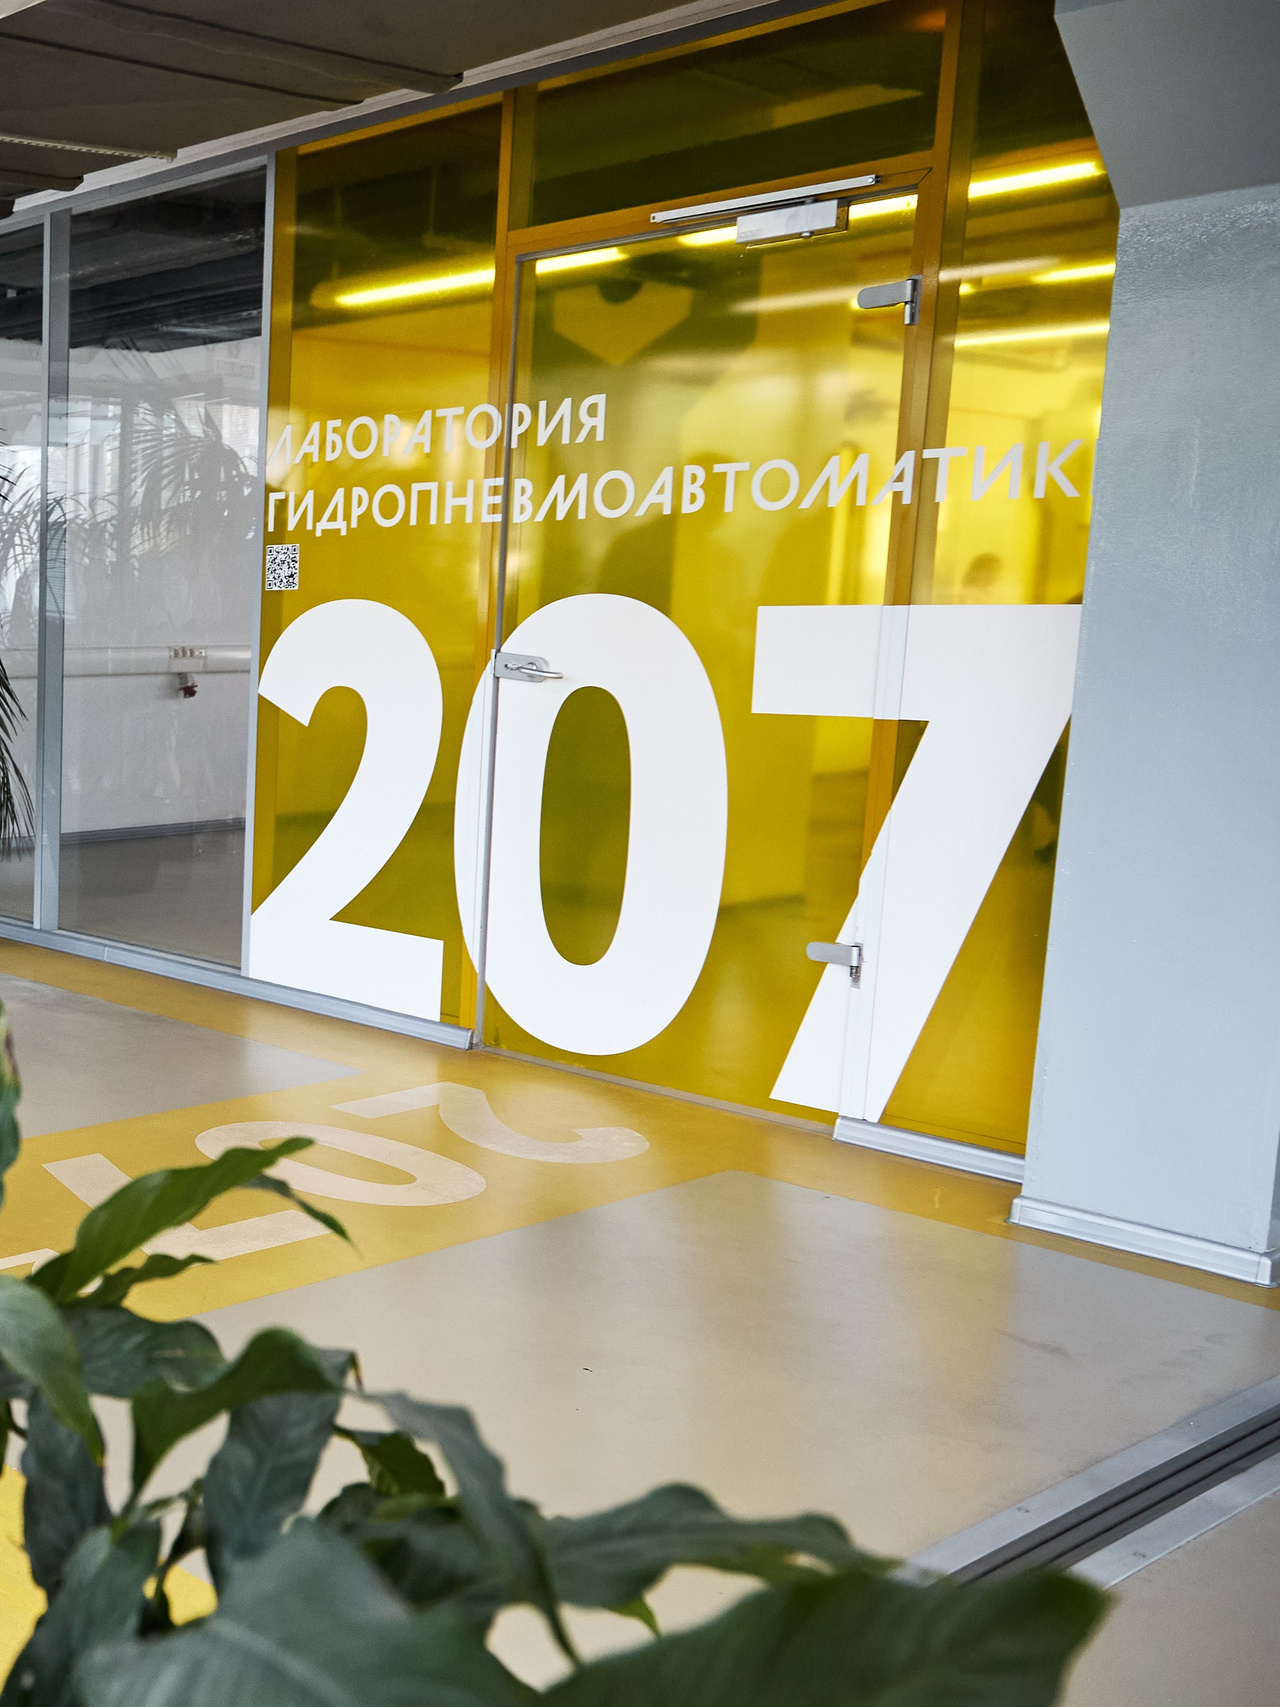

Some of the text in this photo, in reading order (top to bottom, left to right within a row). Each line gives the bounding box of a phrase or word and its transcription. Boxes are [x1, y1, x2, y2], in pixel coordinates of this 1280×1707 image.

[267, 394, 607, 465] ЛАБОРАТОРИЯ
[268, 439, 1094, 537] ГИДРОПНЕВМОАВТОМАТИК
[249, 593, 1082, 1121] 207
